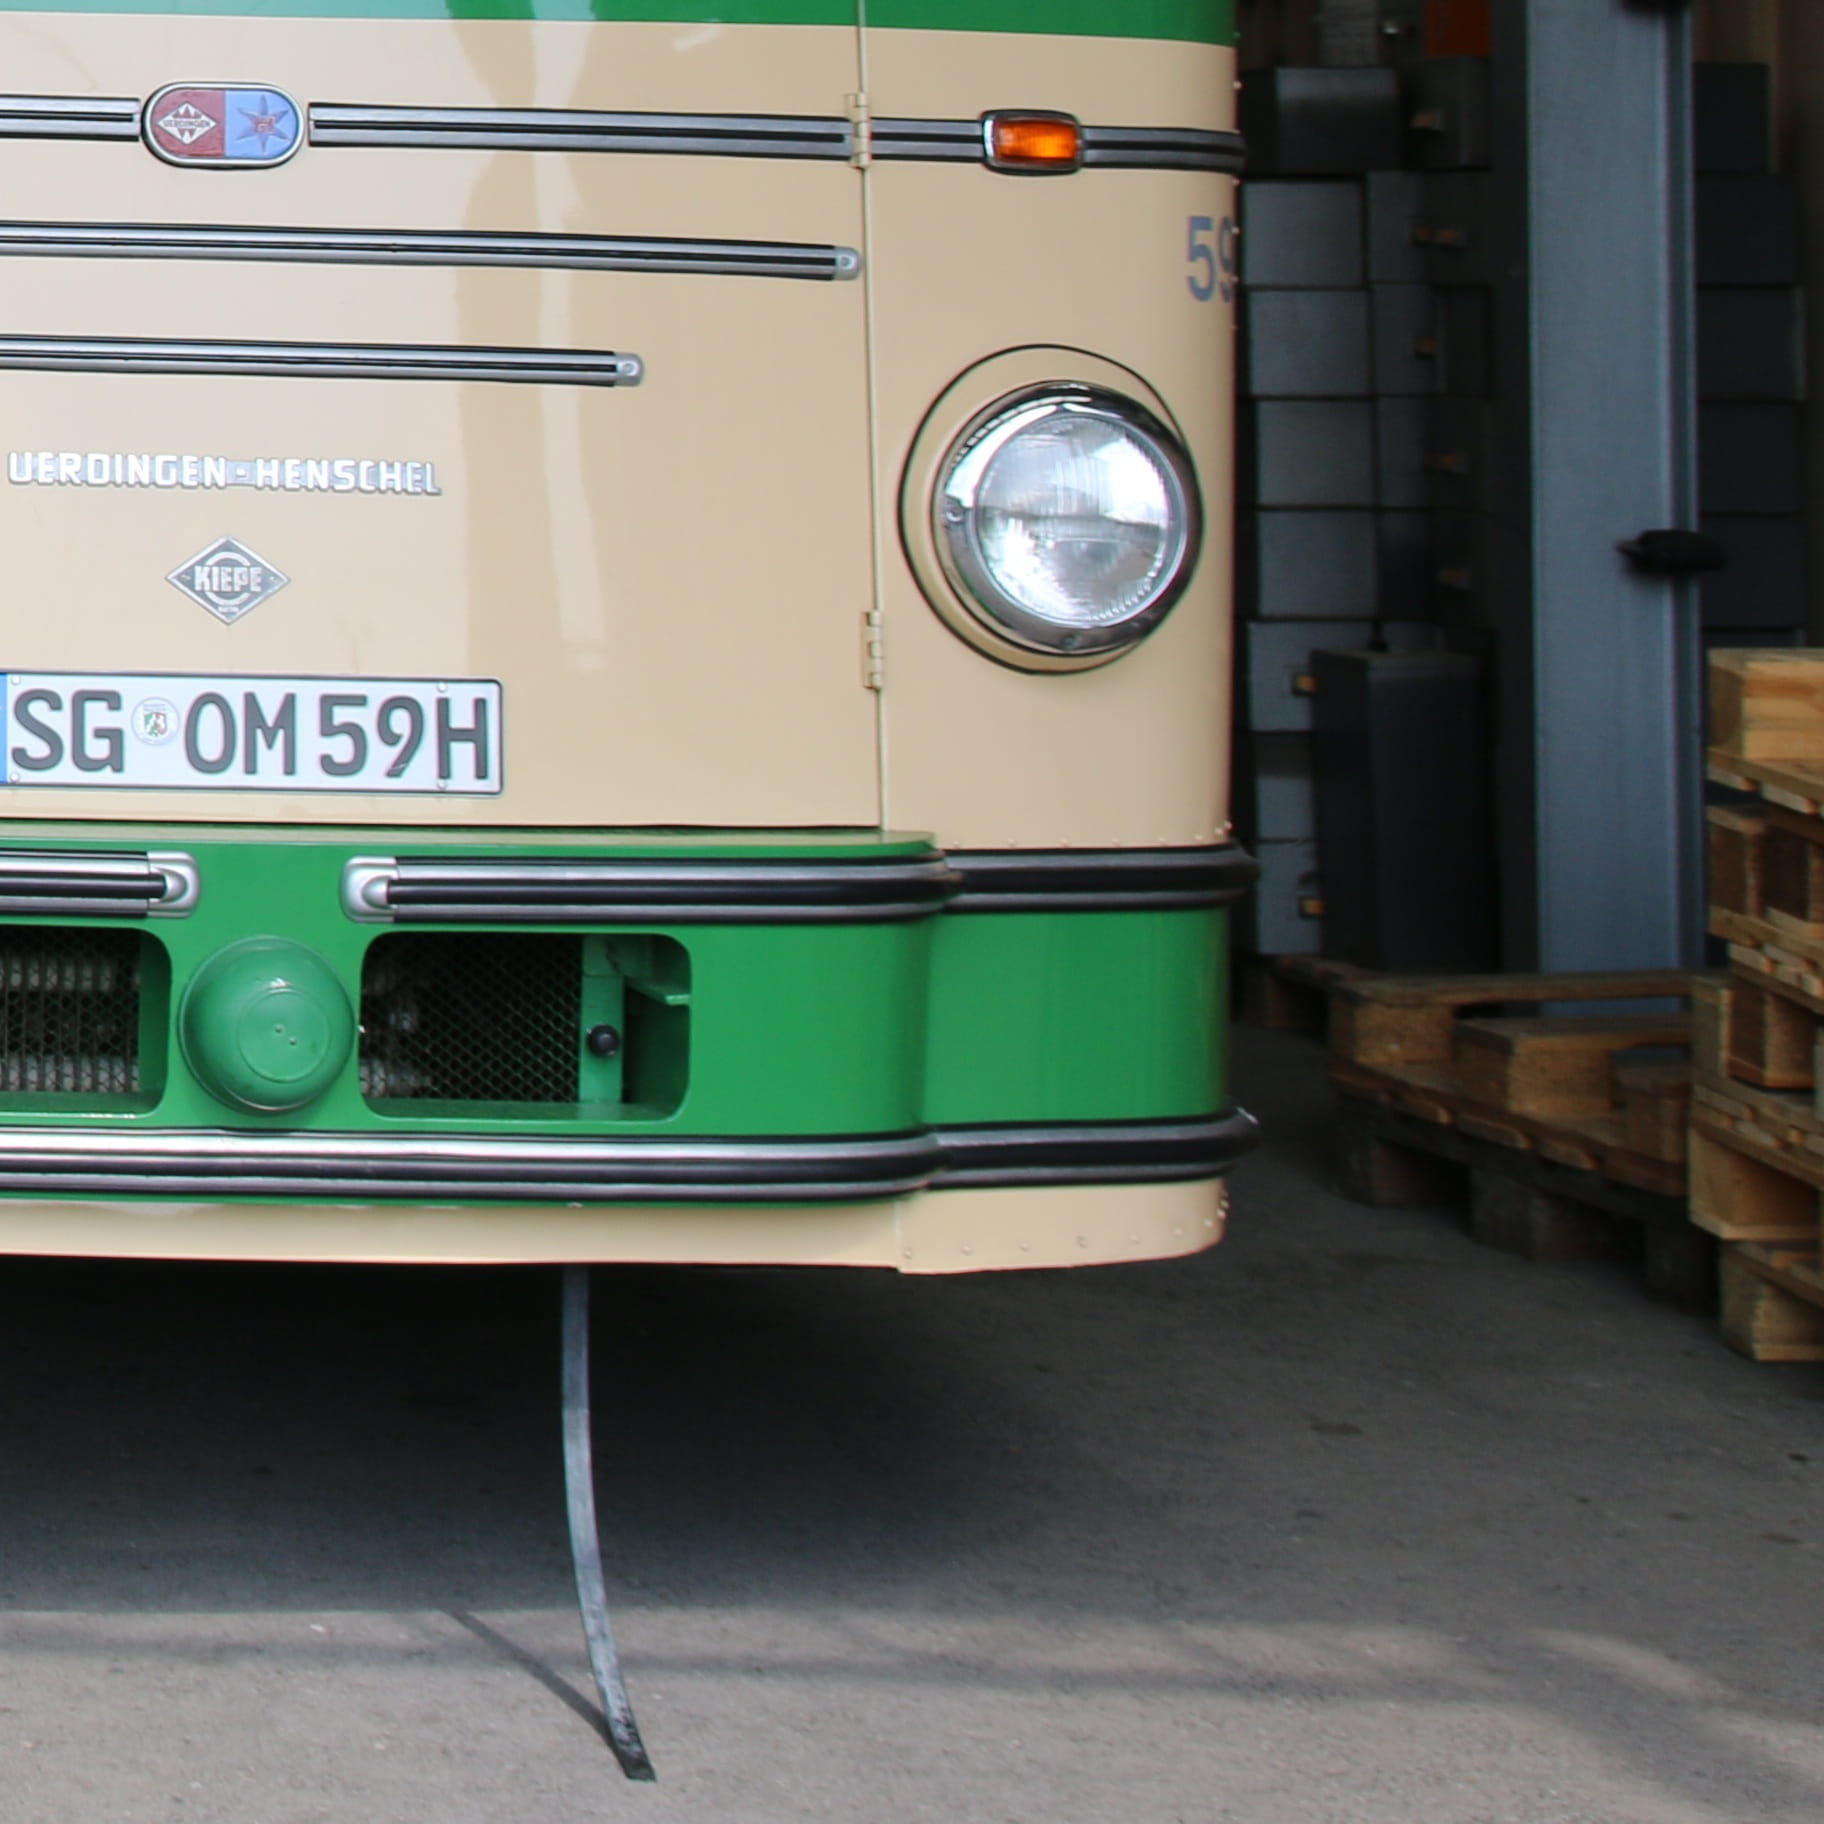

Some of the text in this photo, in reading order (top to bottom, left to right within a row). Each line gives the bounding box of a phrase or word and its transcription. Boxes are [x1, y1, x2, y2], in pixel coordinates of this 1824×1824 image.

[193, 565, 262, 593] KIEPE
[10, 688, 125, 773] SG
[183, 691, 297, 777] OM
[319, 693, 489, 780] 59H
